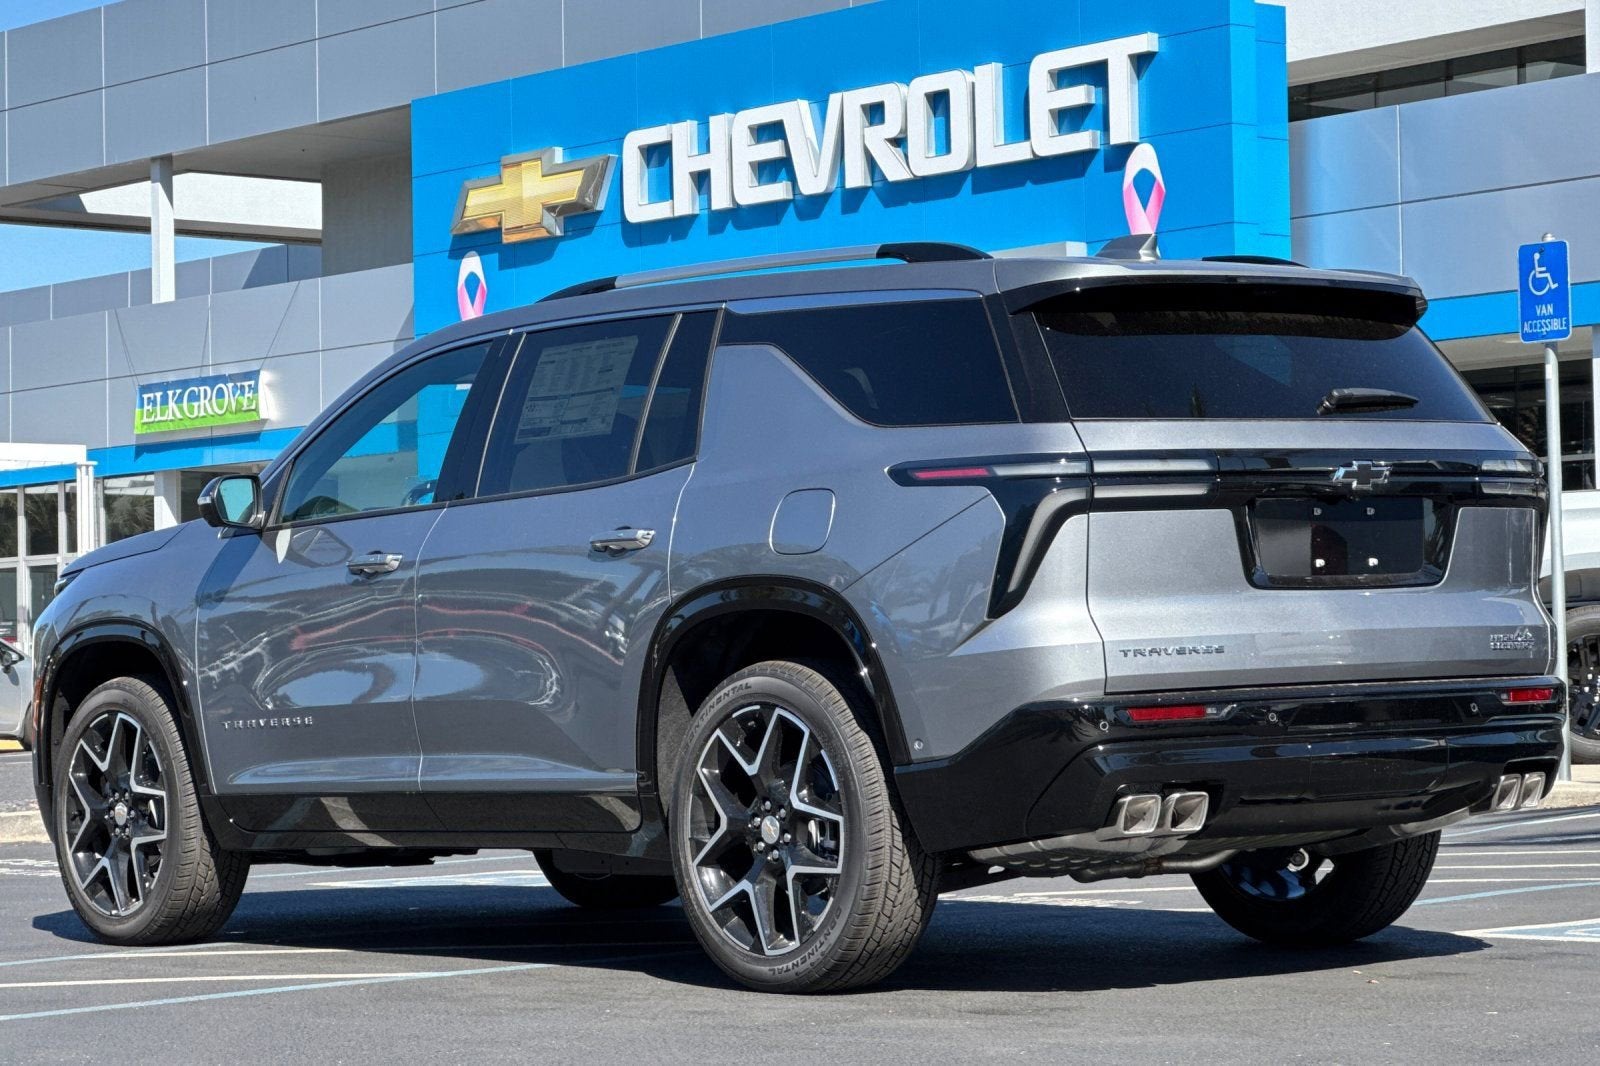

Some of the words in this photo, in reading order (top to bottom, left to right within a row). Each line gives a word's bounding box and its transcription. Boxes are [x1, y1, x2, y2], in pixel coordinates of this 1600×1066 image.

[622, 32, 1158, 223] CHEVROLET
[1535, 303, 1553, 316] VAN
[1523, 317, 1567, 333] ACCESSIBLE
[1119, 645, 1225, 658] TRAVERSE
[221, 716, 313, 729] TRAVERSE
[768, 906, 842, 976] CONTINENTAL
